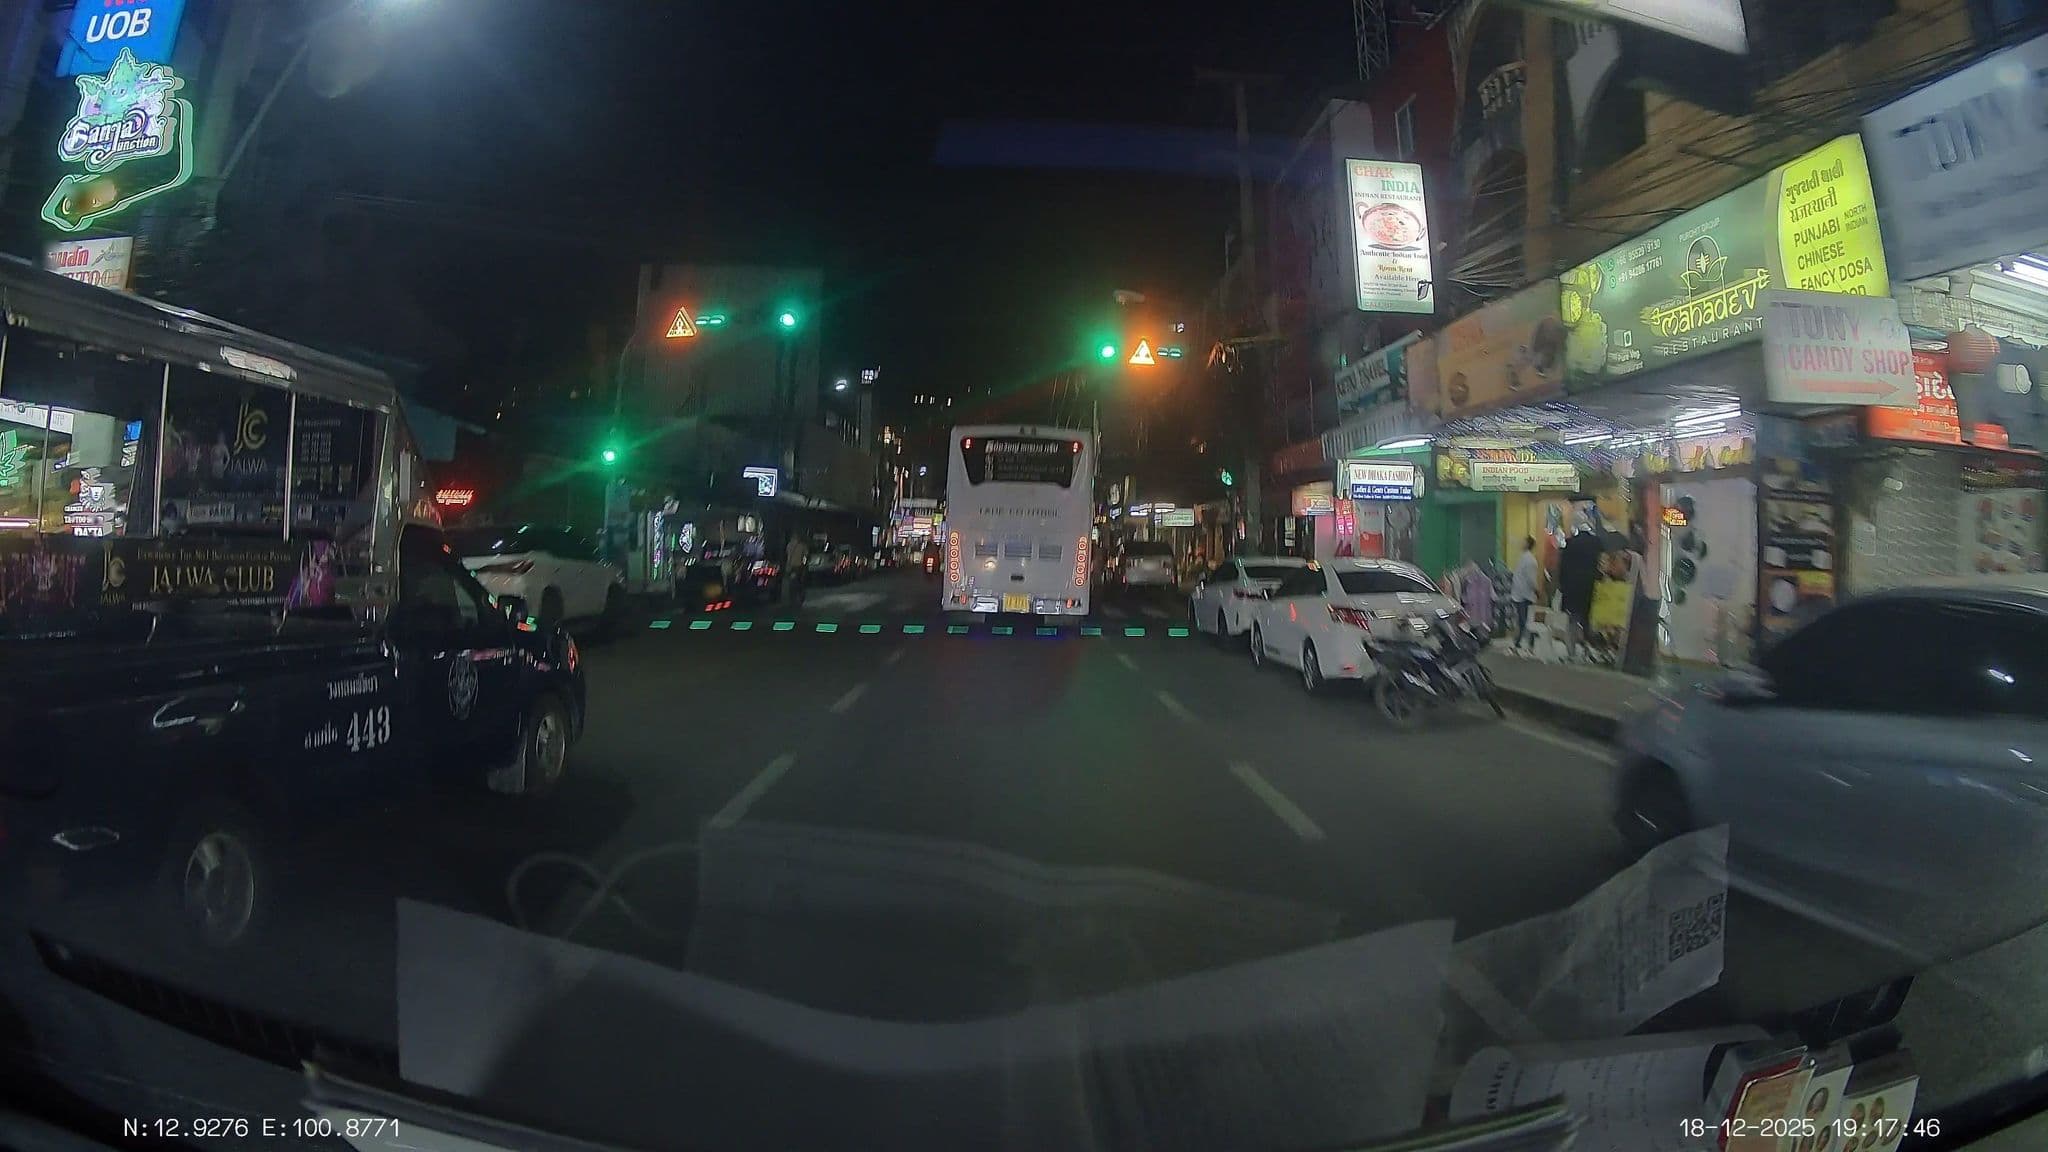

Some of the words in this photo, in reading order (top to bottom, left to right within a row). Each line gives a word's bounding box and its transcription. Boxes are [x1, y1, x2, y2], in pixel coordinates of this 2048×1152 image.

[86, 8, 152, 43] UOB
[1381, 180, 1420, 194] INDIA
[1844, 204, 1867, 220] NORTH
[1794, 217, 1841, 247] PUNJABI
[1797, 241, 1845, 270] CHINESE
[1801, 268, 1837, 291] FANCY
[1840, 257, 1873, 281] DOSA
[1663, 316, 1764, 357] RESTAURANT
[1790, 304, 1860, 342] TONY
[1788, 347, 1854, 373] CANDY
[1862, 349, 1912, 376] SHOP
[1482, 466, 1509, 474] INDIAN
[224, 565, 274, 592] CLUB
[346, 704, 392, 752] 443
